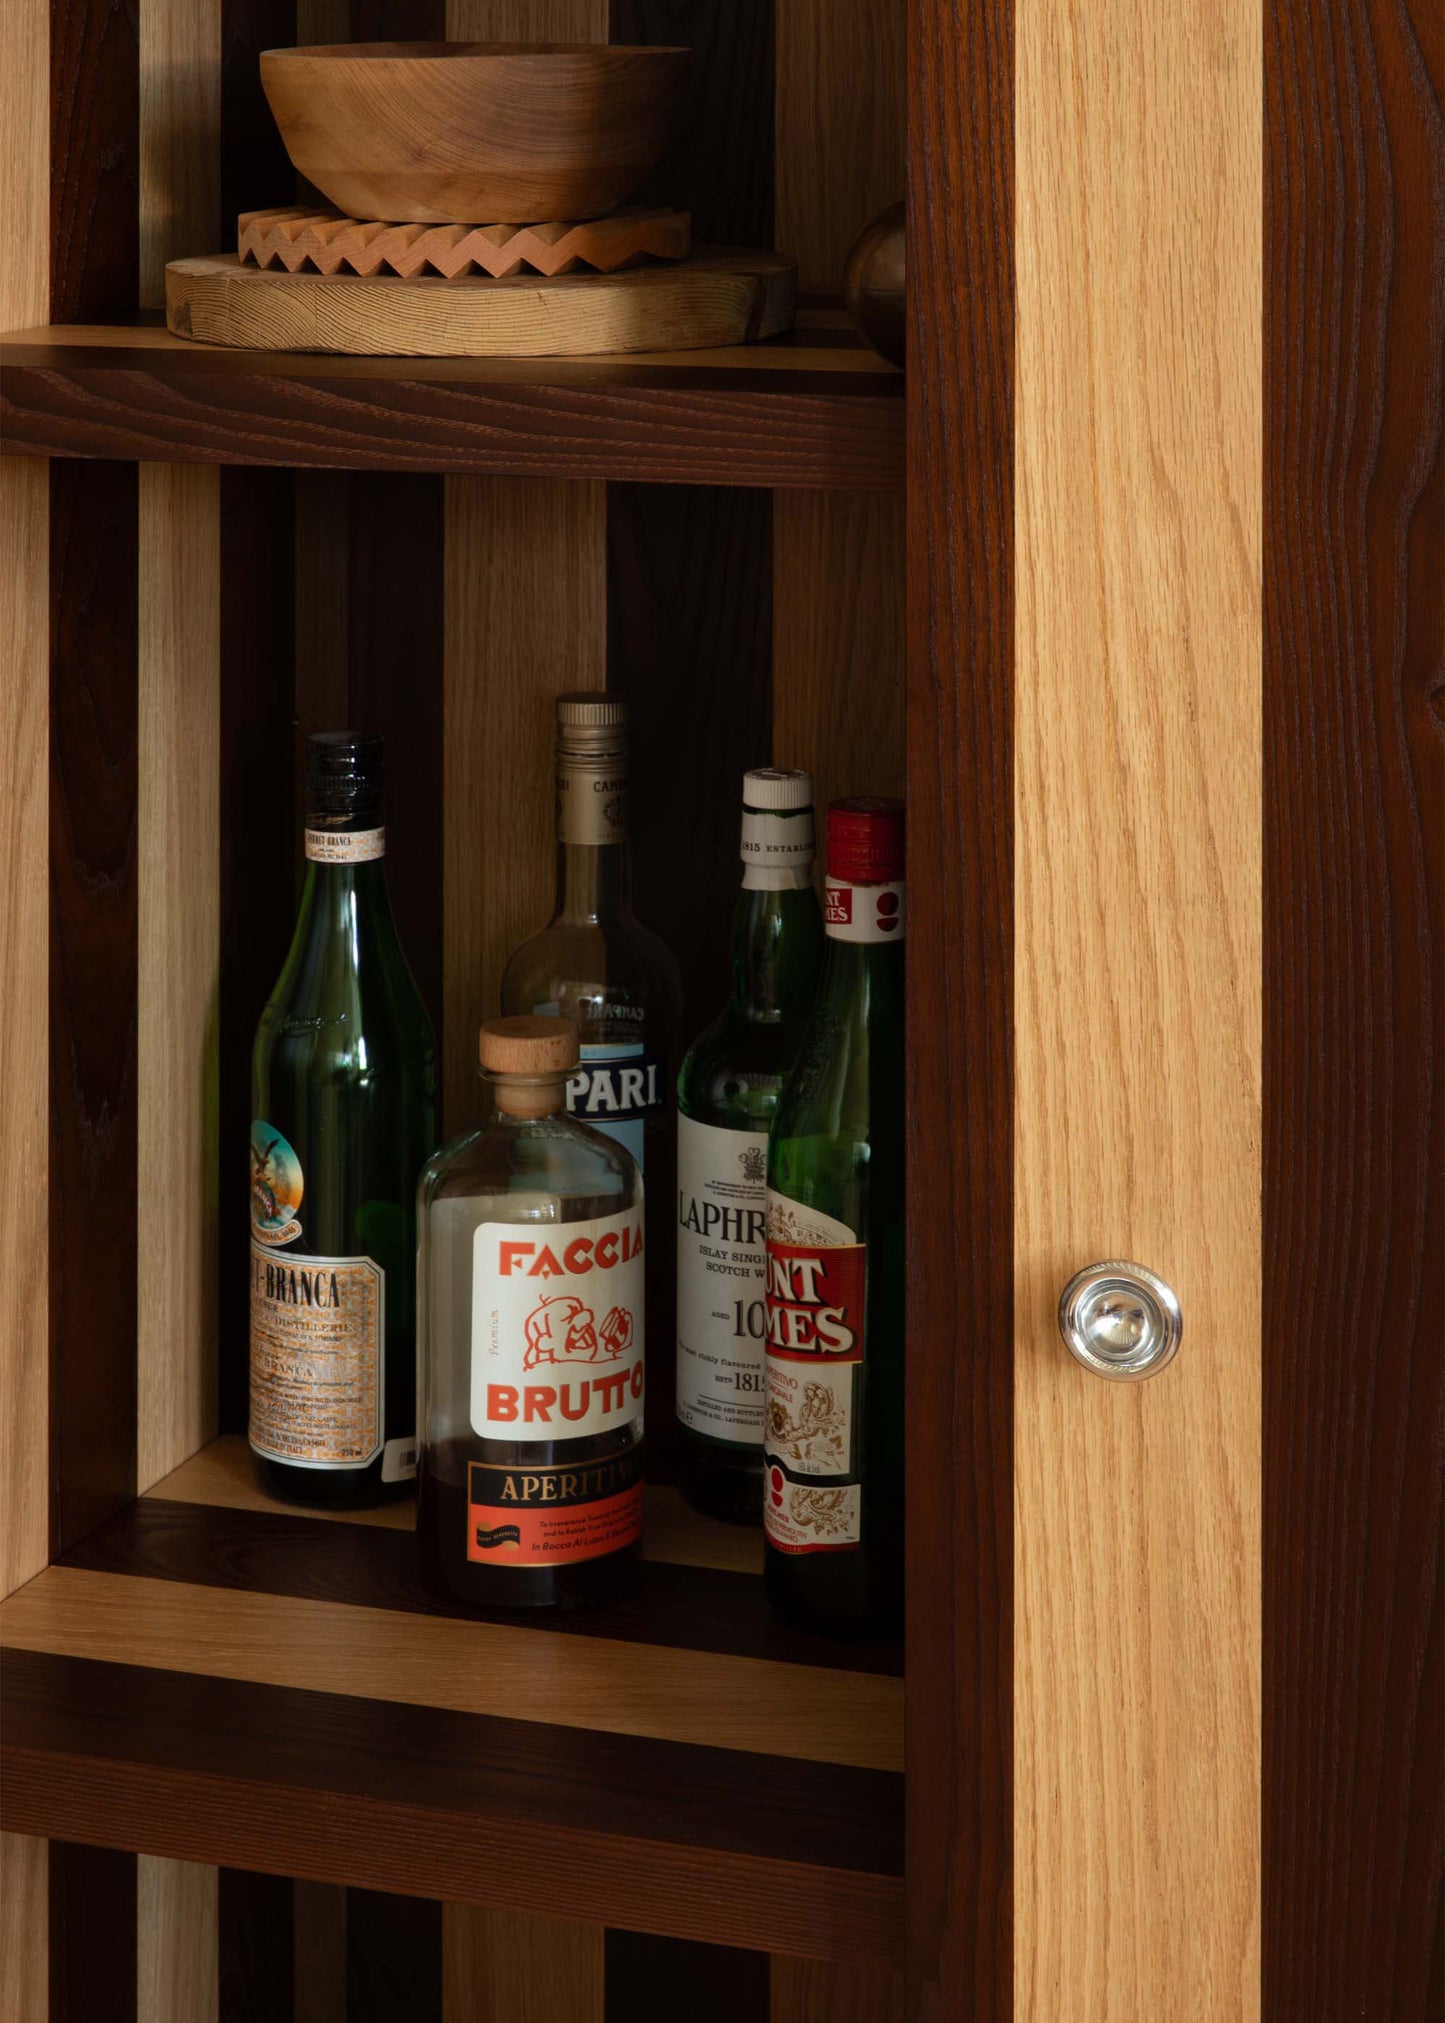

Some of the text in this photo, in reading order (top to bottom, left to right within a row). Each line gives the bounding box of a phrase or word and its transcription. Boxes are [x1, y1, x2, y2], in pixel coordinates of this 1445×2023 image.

[499, 1222, 643, 1280] FACCIA
[699, 1244, 729, 1261] ISLAY
[705, 1261, 751, 1278] SCOTCH
[732, 1299, 766, 1340] 10
[698, 1352, 719, 1365] richly
[720, 1358, 761, 1371] flavoured
[486, 1360, 643, 1423] BRUTTO
[532, 1542, 541, 1551] In
[541, 1541, 571, 1551] Bocca
